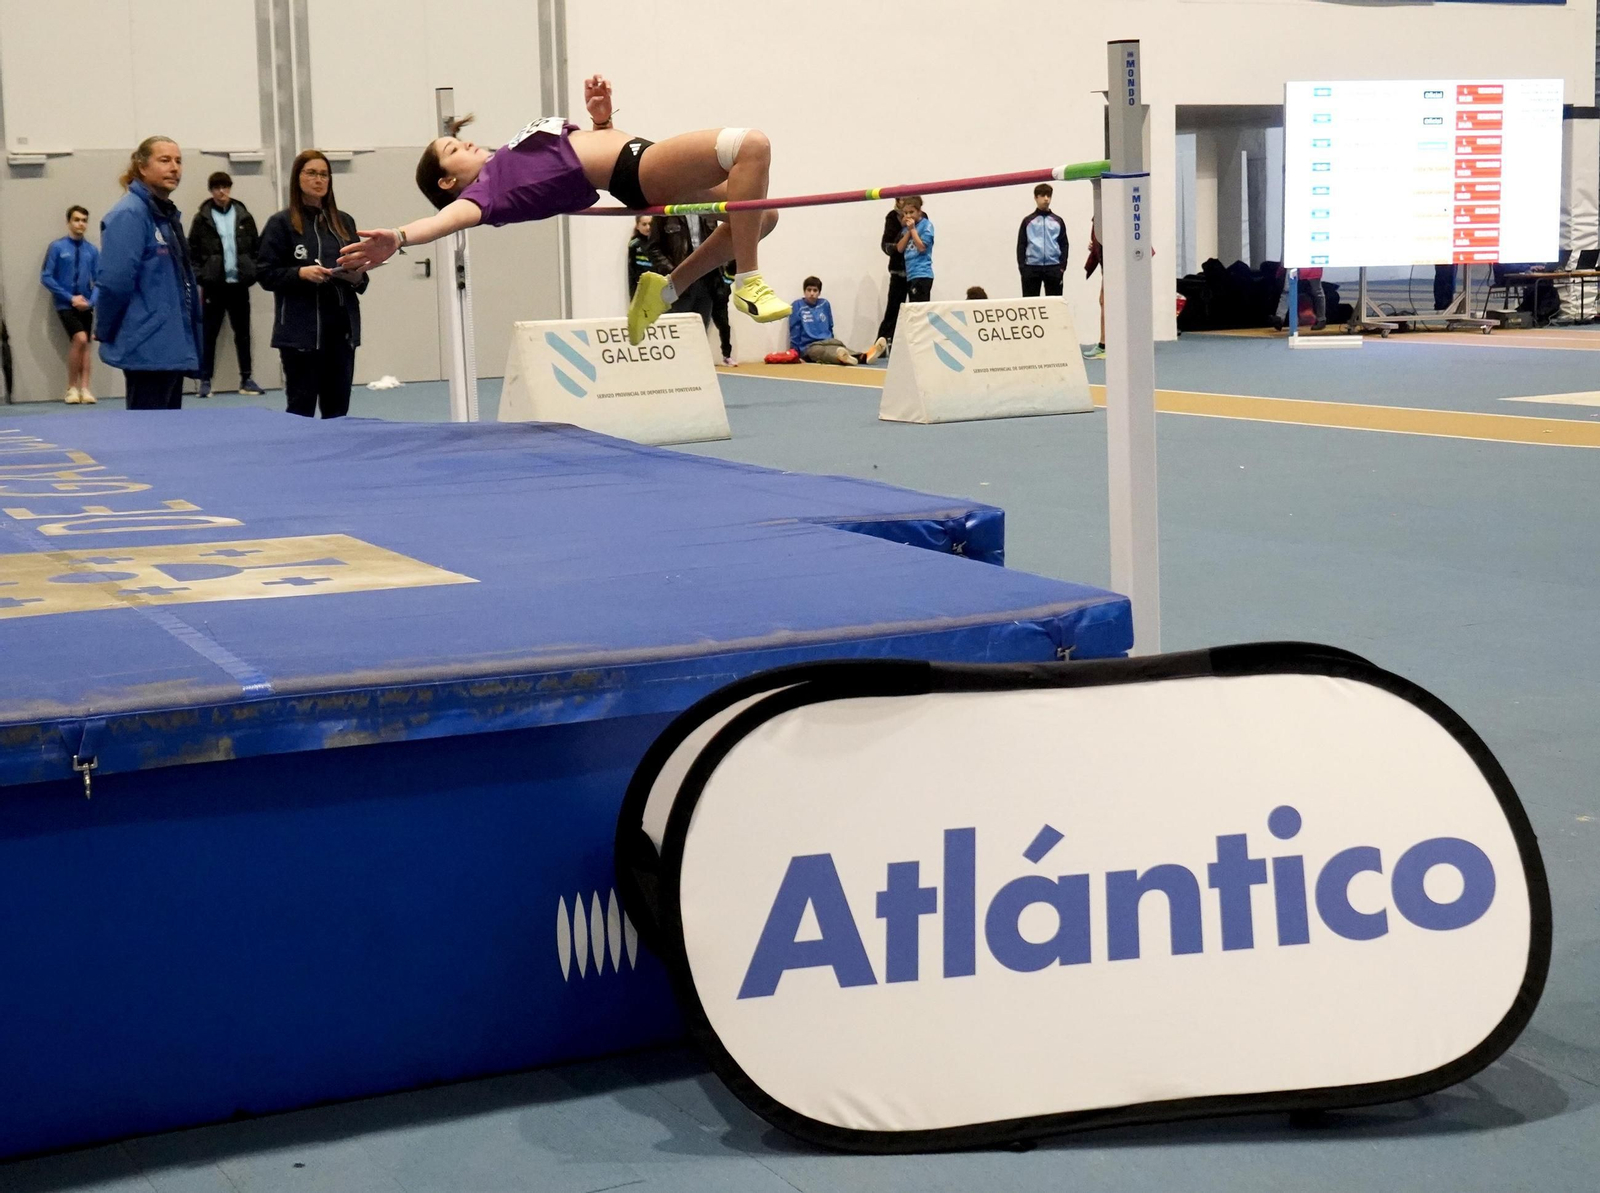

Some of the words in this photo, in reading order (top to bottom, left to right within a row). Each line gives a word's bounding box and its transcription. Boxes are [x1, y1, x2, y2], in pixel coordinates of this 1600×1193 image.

[1126, 59, 1136, 106] MONDO
[1131, 194, 1142, 241] MONDO
[972, 306, 1049, 324] DEPORTE
[596, 324, 680, 344] DEPRTE
[977, 324, 1045, 342] GALEGO
[601, 344, 676, 364] GALEGO
[596, 392, 615, 400] SERVIZO
[647, 388, 668, 396] DEPORTES
[736, 804, 1497, 1000] Atlántico
